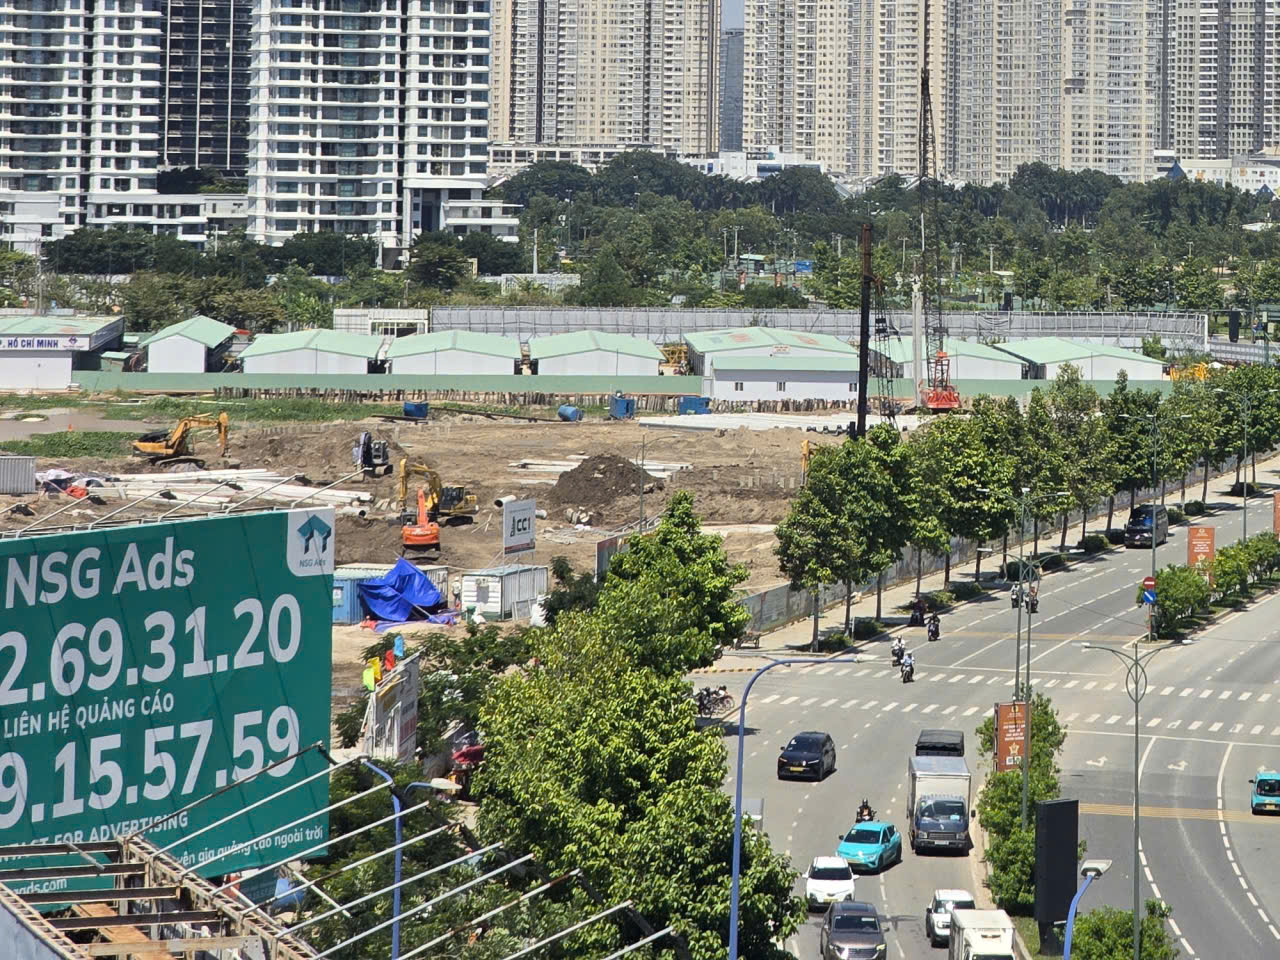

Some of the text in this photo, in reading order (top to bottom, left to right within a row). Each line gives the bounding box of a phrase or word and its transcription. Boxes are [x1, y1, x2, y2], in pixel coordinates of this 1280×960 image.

[37, 339, 59, 349] MINH
[6, 536, 196, 609] NSG Ads
[299, 559, 313, 568] NSG
[3, 688, 175, 739] LIÊN HỆ QUẢNG CÁO
[274, 828, 304, 849] ngoài
